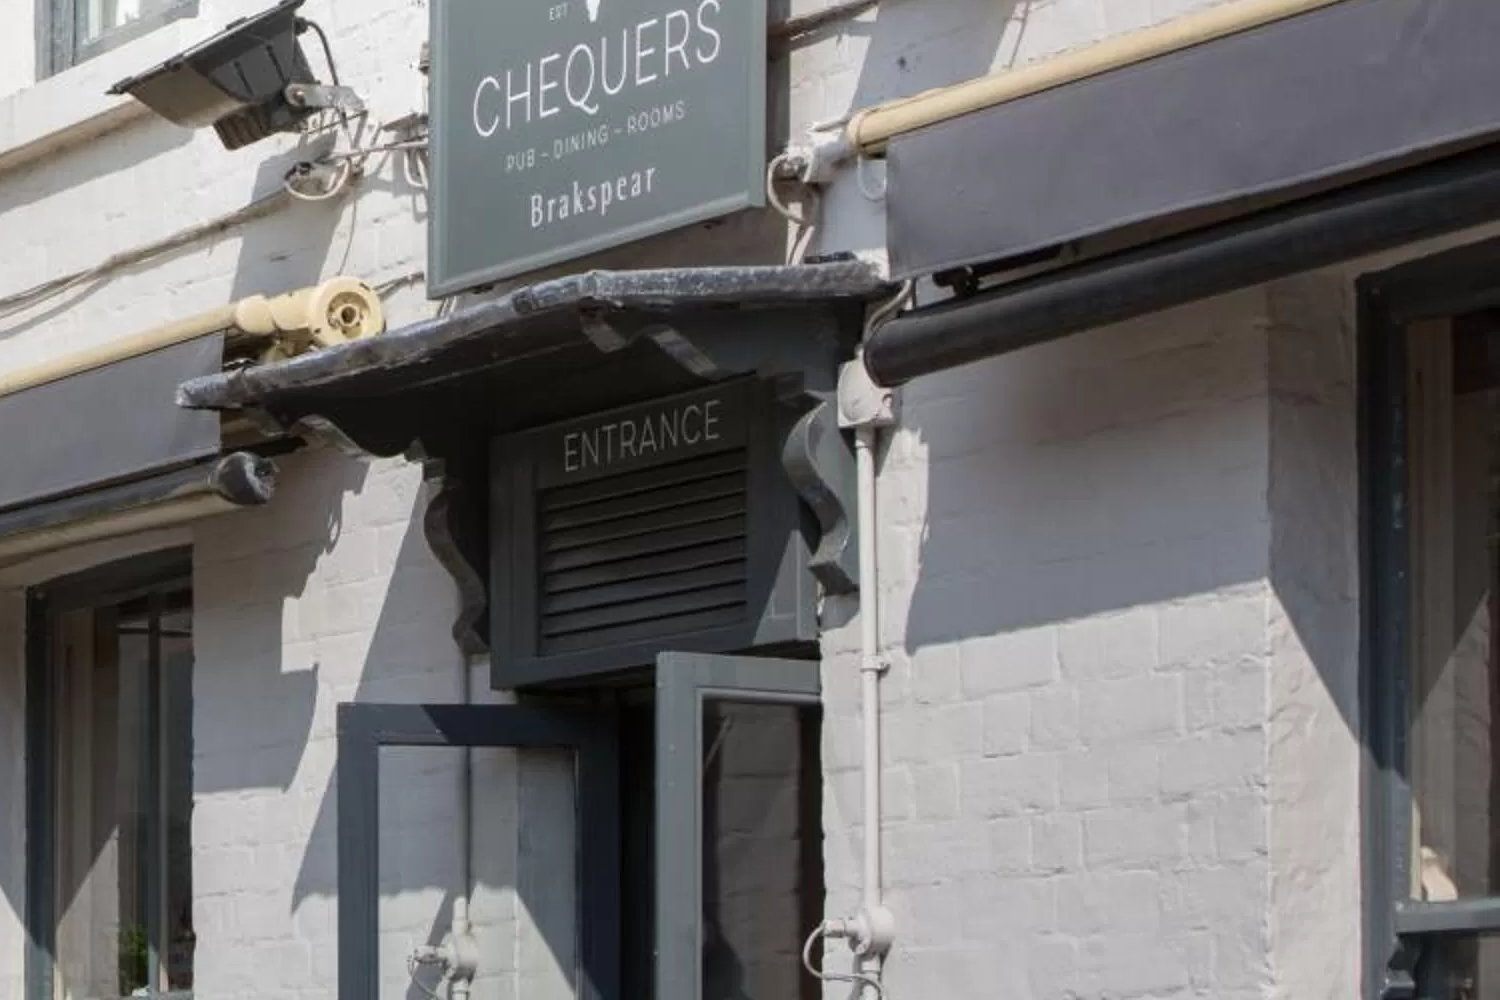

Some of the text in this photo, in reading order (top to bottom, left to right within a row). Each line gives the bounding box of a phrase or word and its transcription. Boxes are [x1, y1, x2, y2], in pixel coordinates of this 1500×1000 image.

[506, 151, 536, 172] PUB
[553, 124, 609, 160] DINING
[627, 101, 686, 133] ROOMS
[530, 165, 657, 229] Brakspear
[563, 399, 722, 473] ENTRANCE
